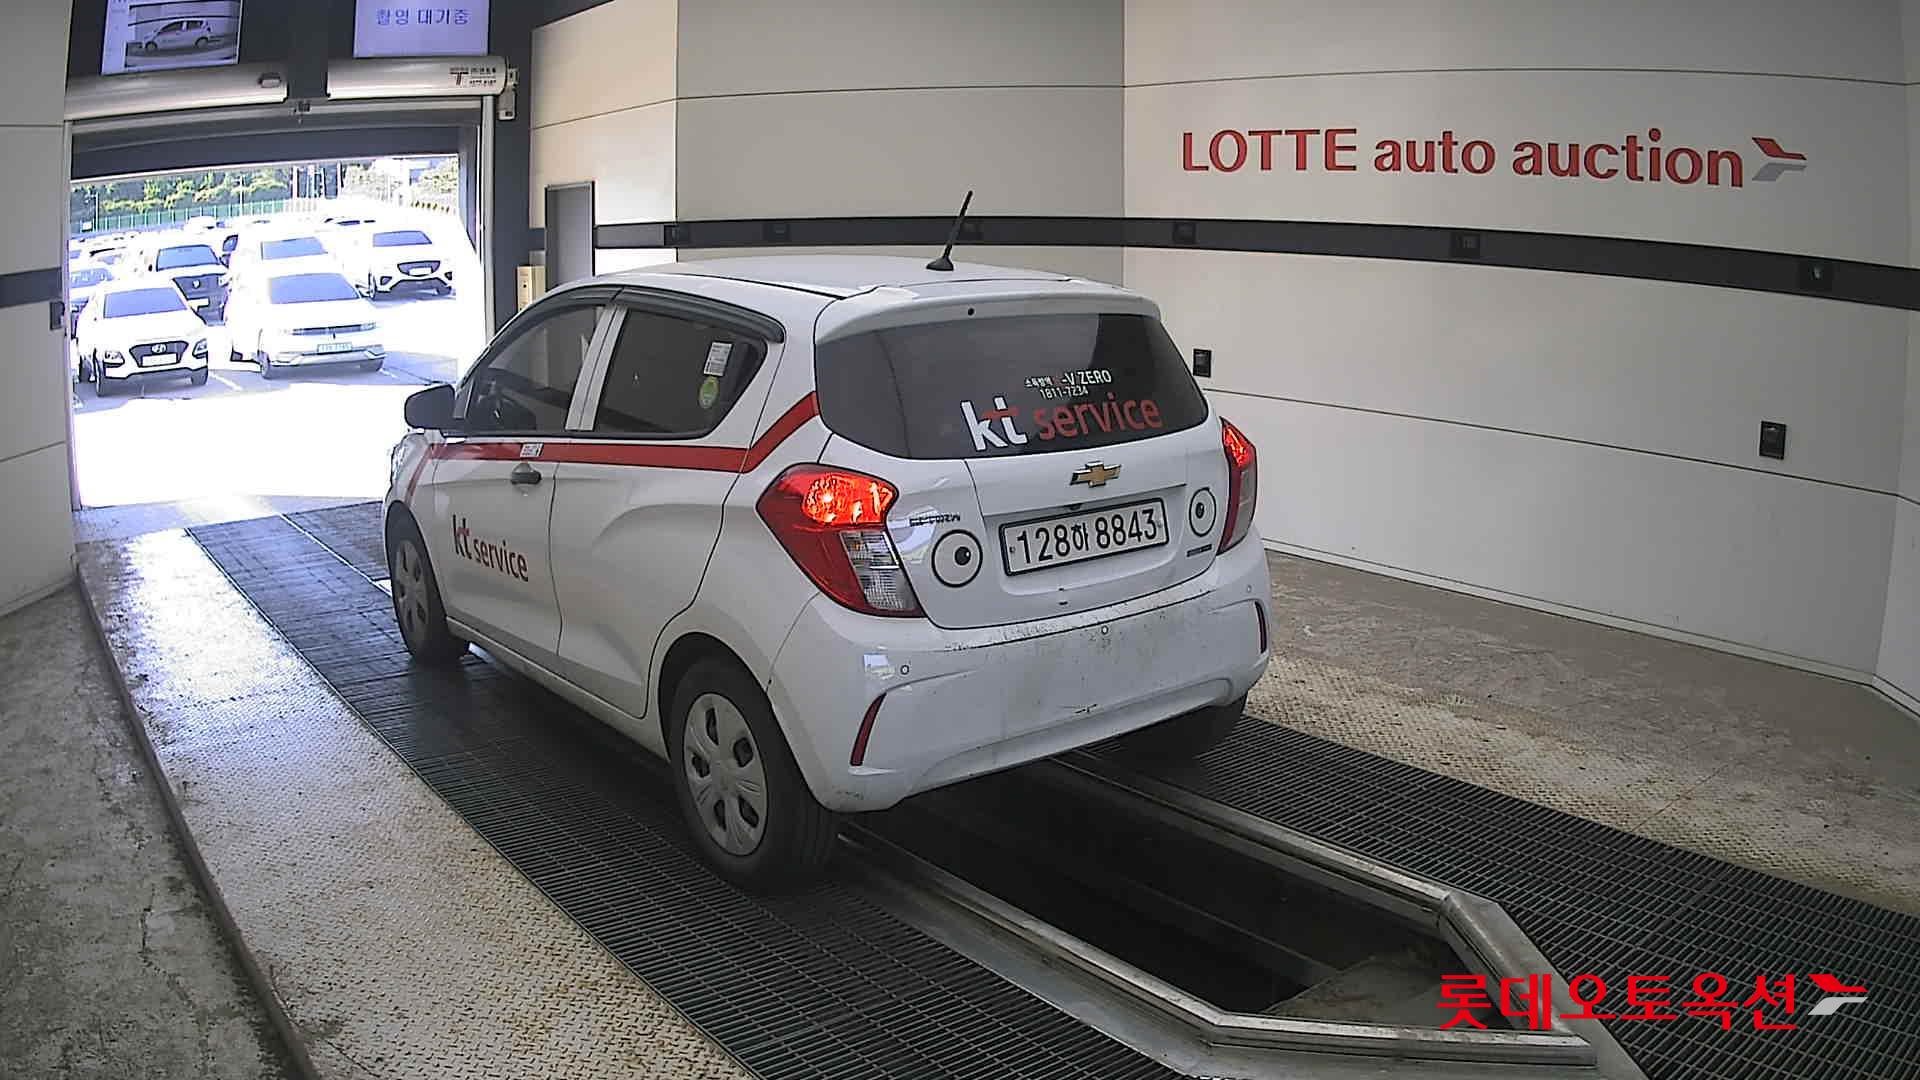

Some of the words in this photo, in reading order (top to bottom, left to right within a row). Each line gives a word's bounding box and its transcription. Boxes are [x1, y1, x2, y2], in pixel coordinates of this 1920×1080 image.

[417, 8, 468, 25] 대기중
[1182, 128, 1357, 172] LOTTE
[1374, 129, 1496, 175] auto
[1512, 127, 1744, 188] auction
[1077, 369, 1113, 386] ZERO
[961, 395, 1029, 452] kt
[1032, 391, 1164, 441] service
[452, 513, 472, 560] kt
[472, 539, 529, 583] service
[1016, 521, 1089, 565] 128하
[1095, 507, 1158, 550] 8843
